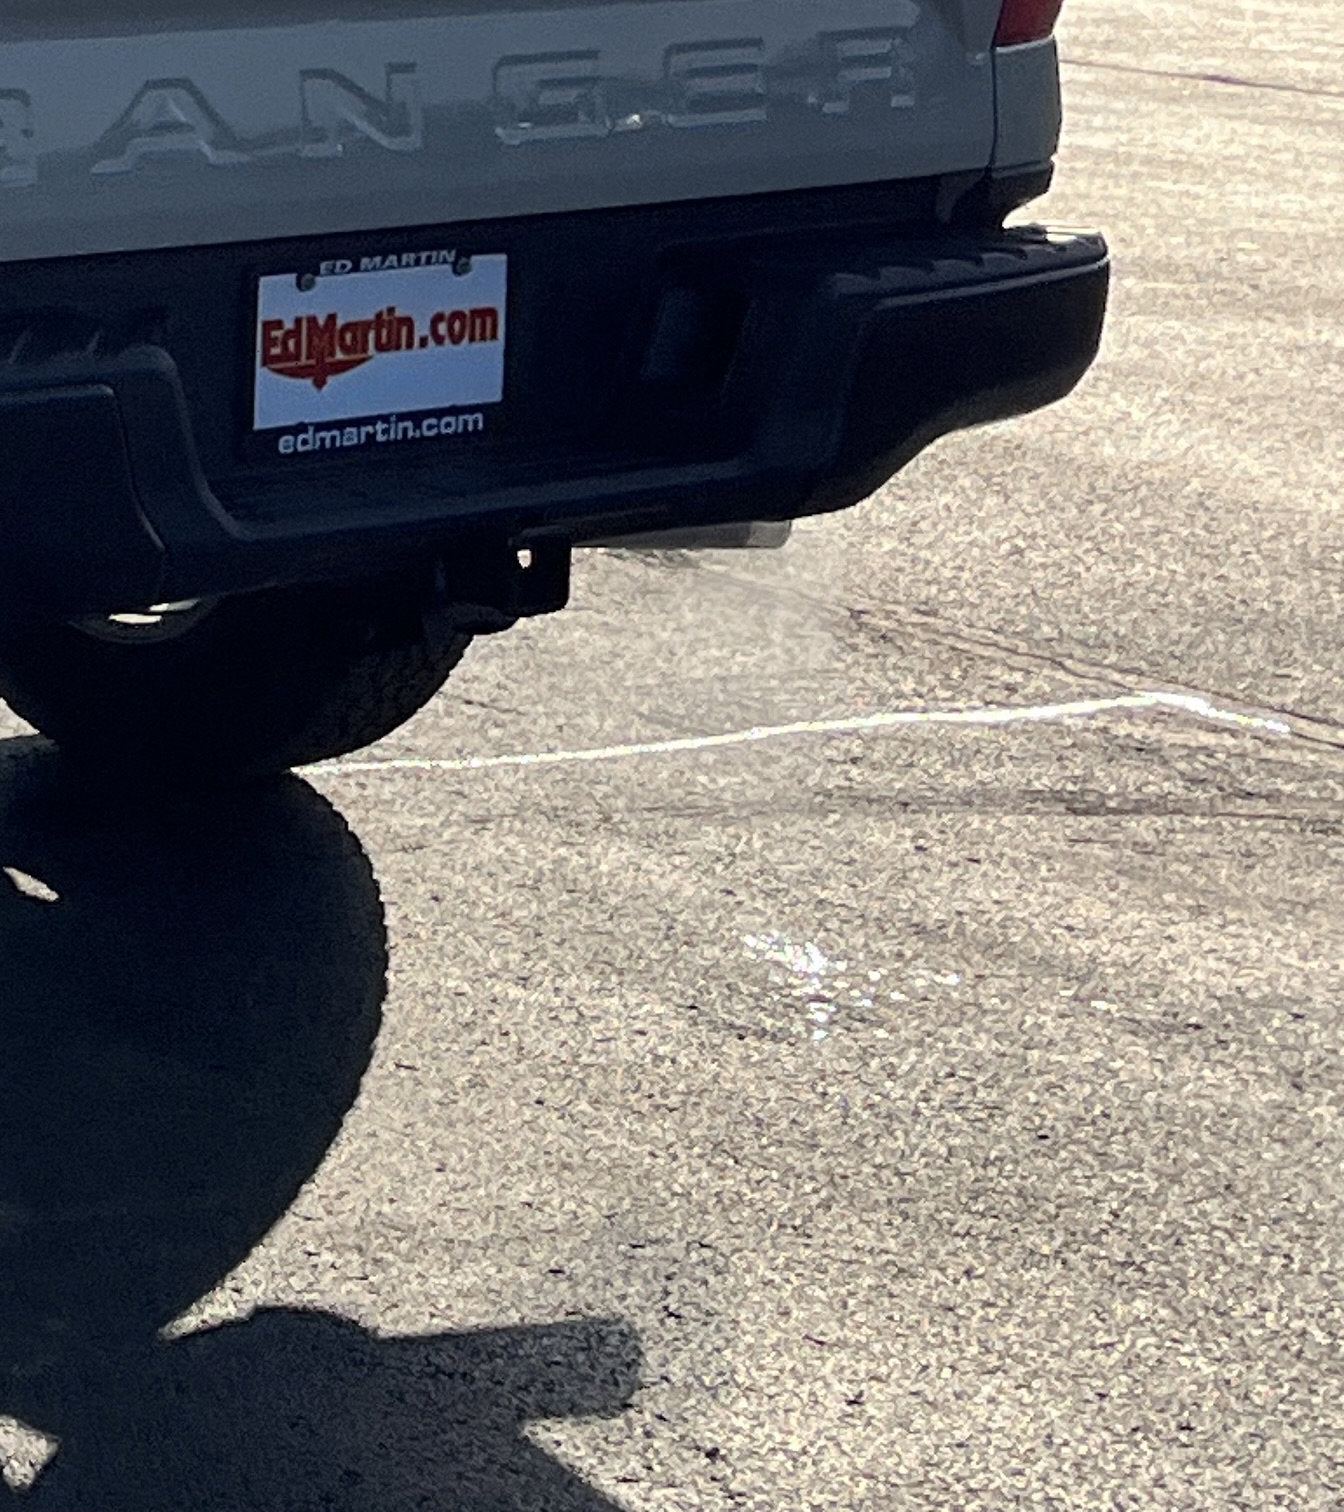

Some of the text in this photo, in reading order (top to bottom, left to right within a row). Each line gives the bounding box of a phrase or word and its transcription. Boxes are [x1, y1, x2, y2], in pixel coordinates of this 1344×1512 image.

[319, 248, 457, 275] ED MARTIN
[278, 411, 484, 454] edmartin.com
